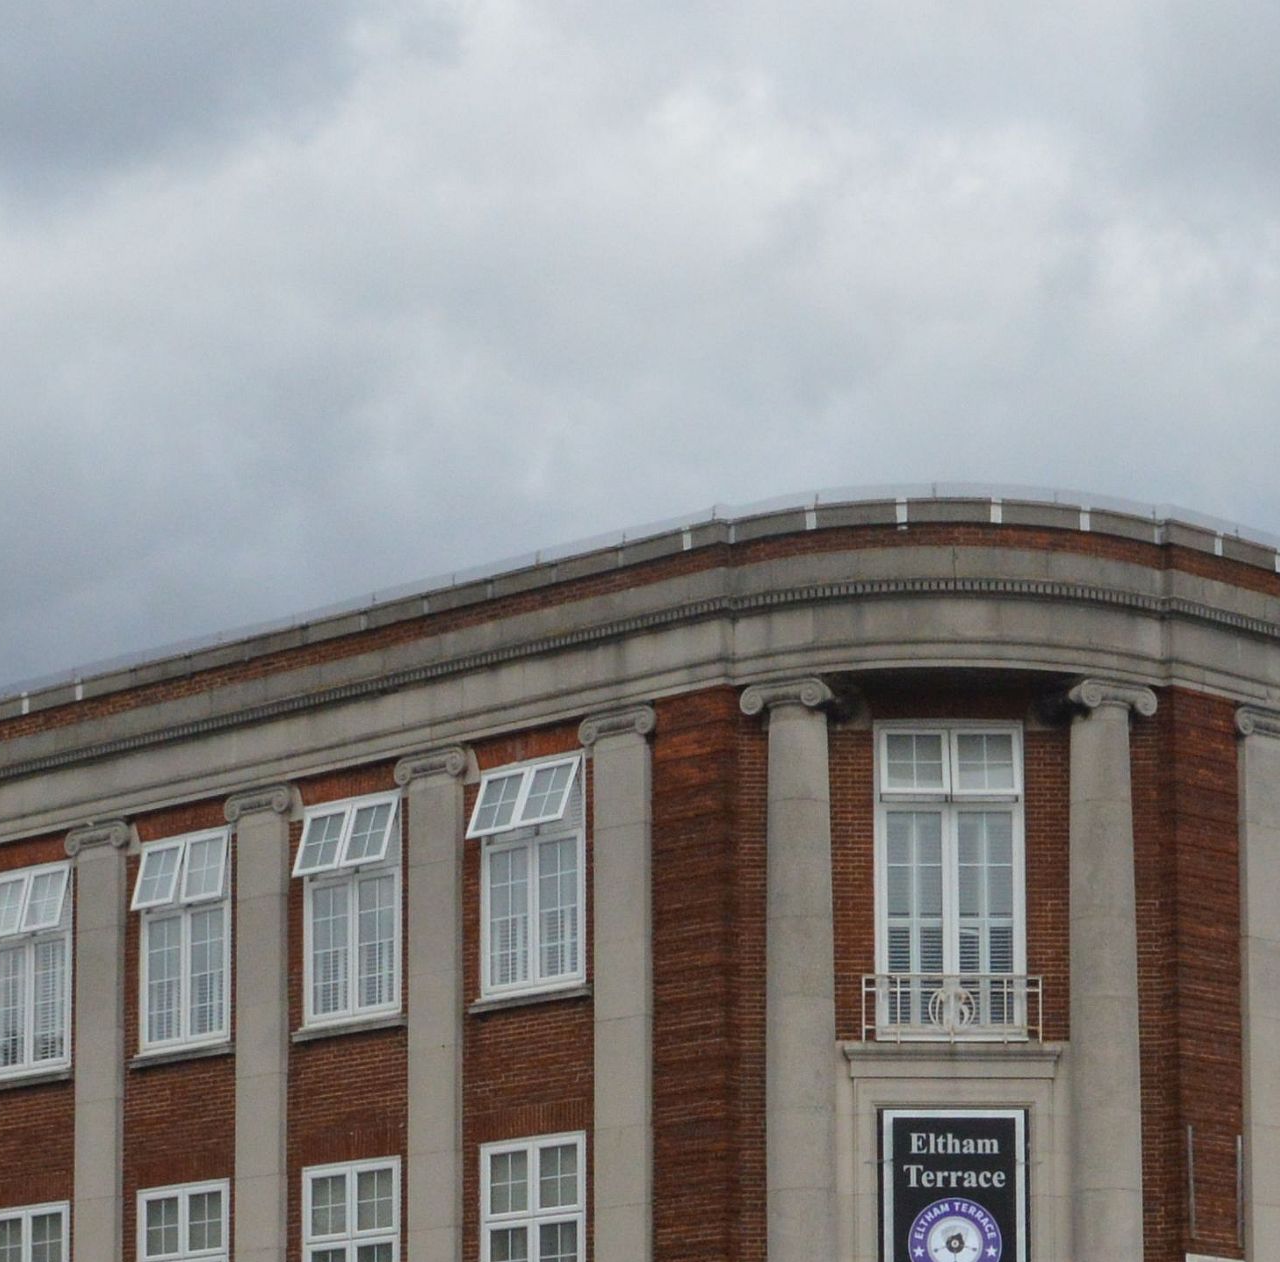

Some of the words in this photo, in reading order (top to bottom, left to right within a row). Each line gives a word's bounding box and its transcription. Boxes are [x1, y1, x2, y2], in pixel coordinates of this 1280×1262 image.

[910, 1132, 1000, 1154] Eltham
[903, 1165, 1006, 1188] Terrace
[914, 1202, 950, 1240] ELTHAM
[954, 1202, 997, 1240] TERRACE
